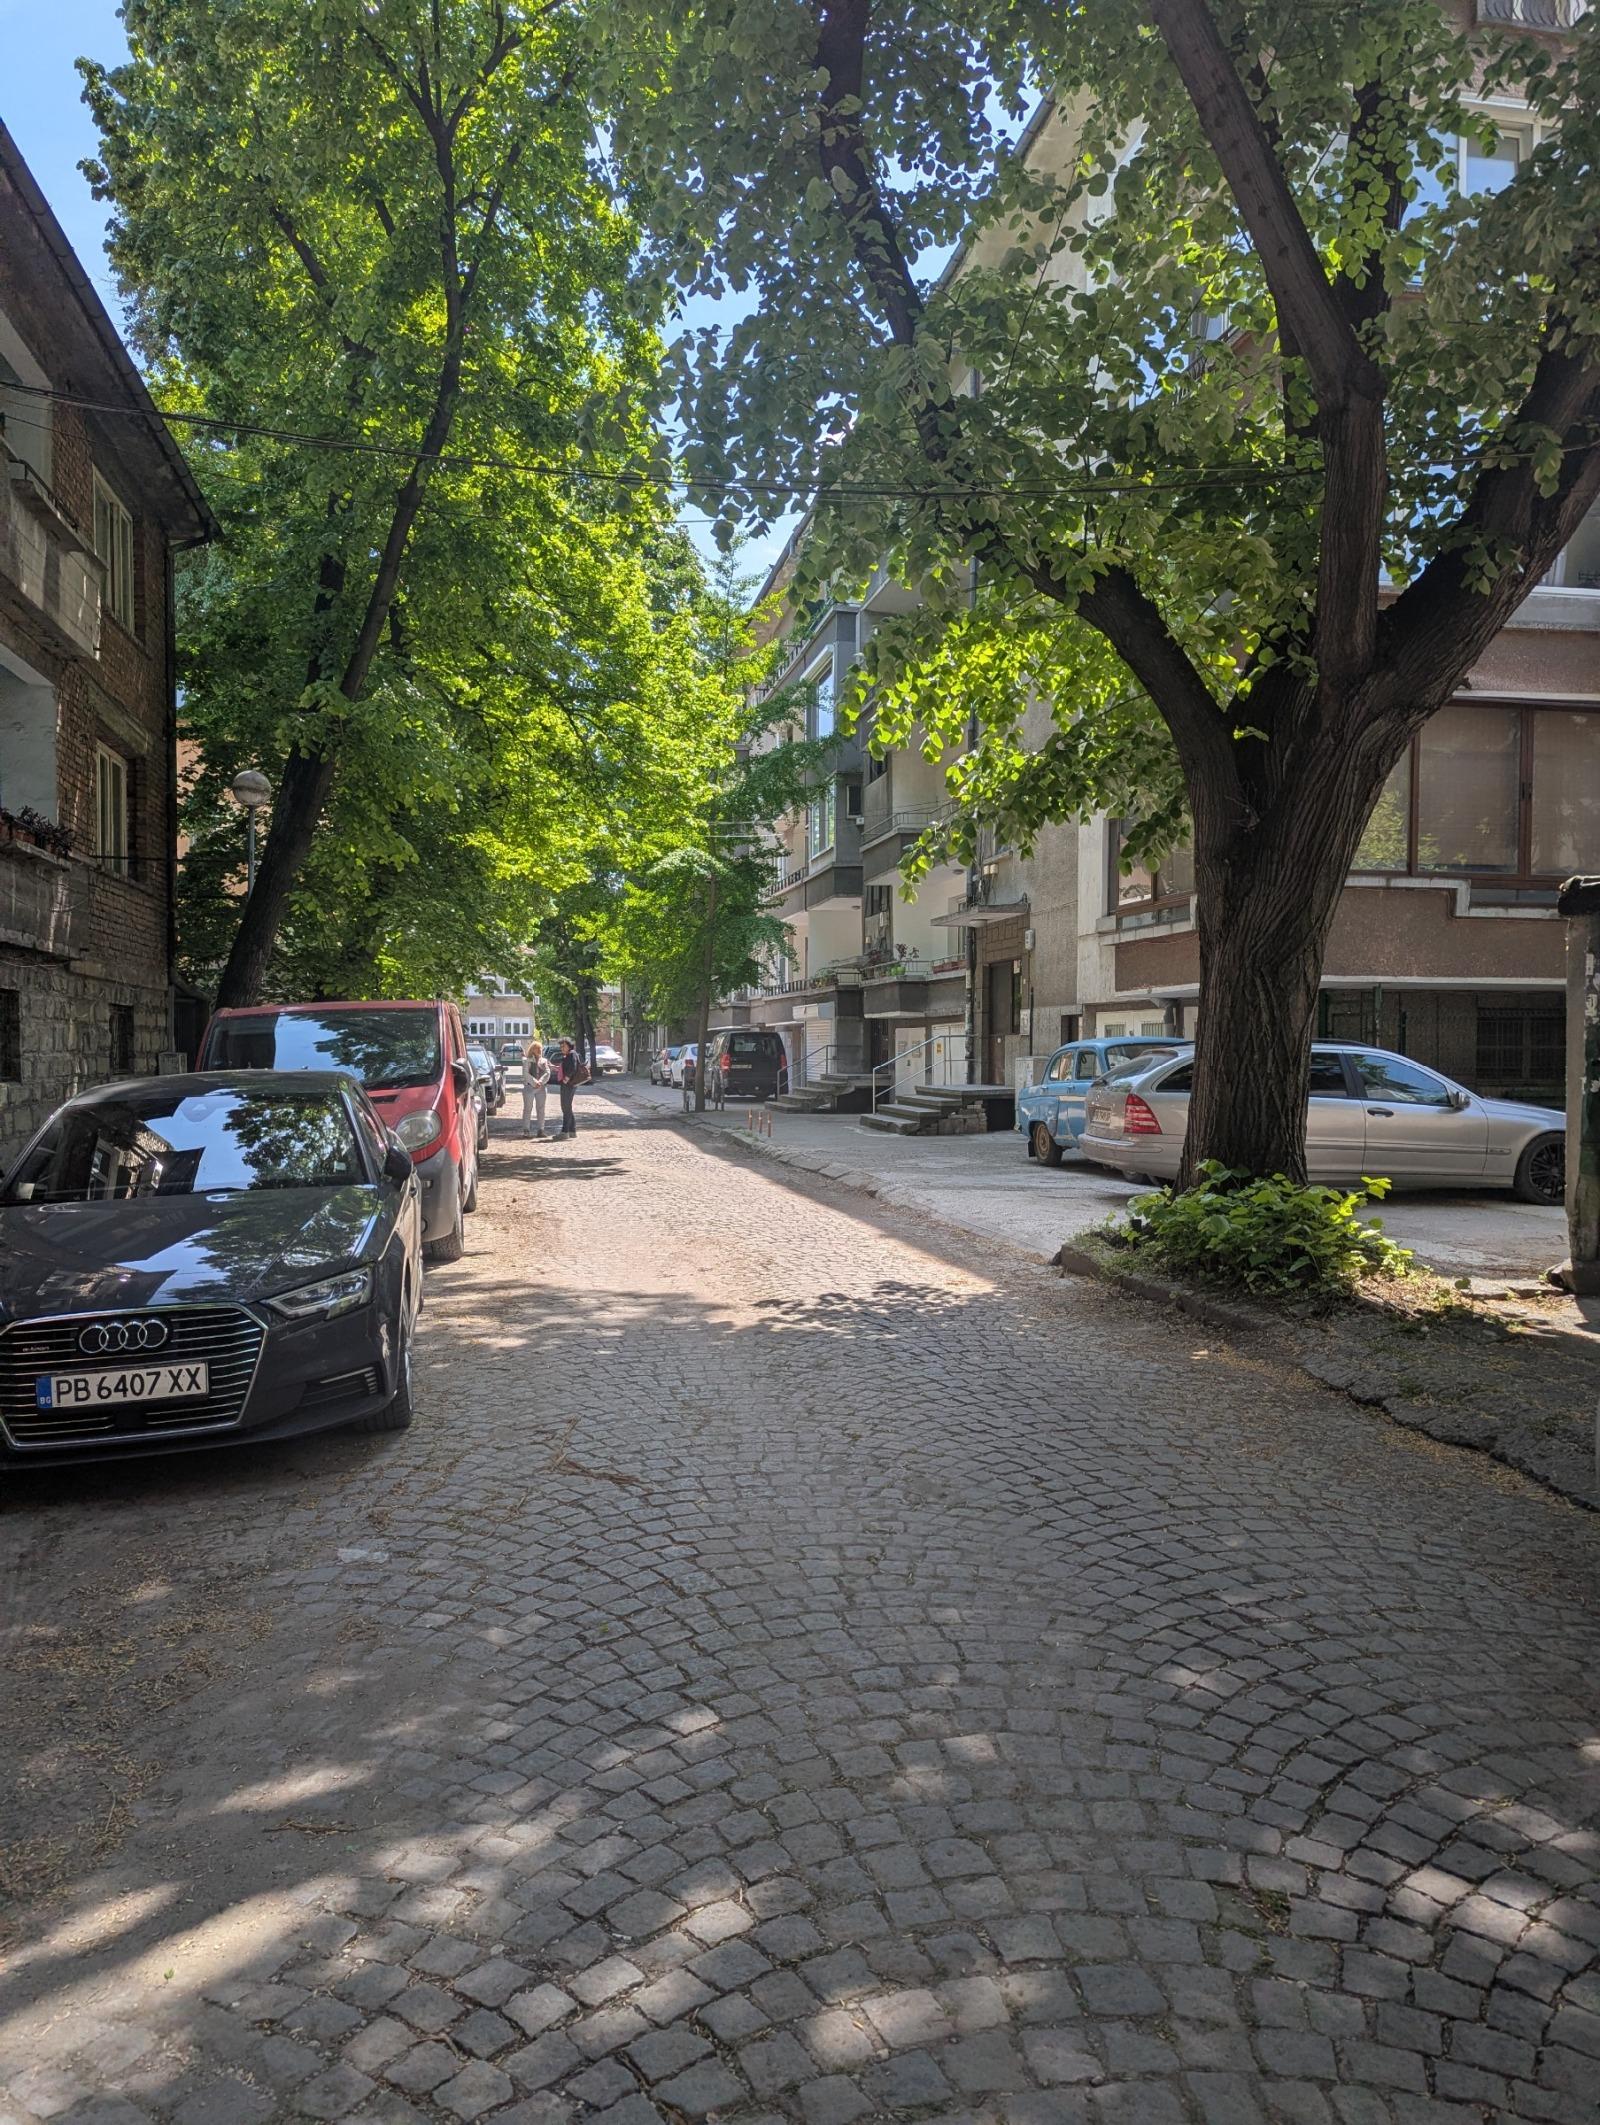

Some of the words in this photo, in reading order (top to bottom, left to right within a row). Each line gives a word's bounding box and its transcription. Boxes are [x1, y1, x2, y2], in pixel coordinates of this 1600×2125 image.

[56, 1378, 91, 1404] PB
[96, 1371, 161, 1400] 6407
[168, 1367, 202, 1393] XX
[40, 1396, 52, 1405] BG
